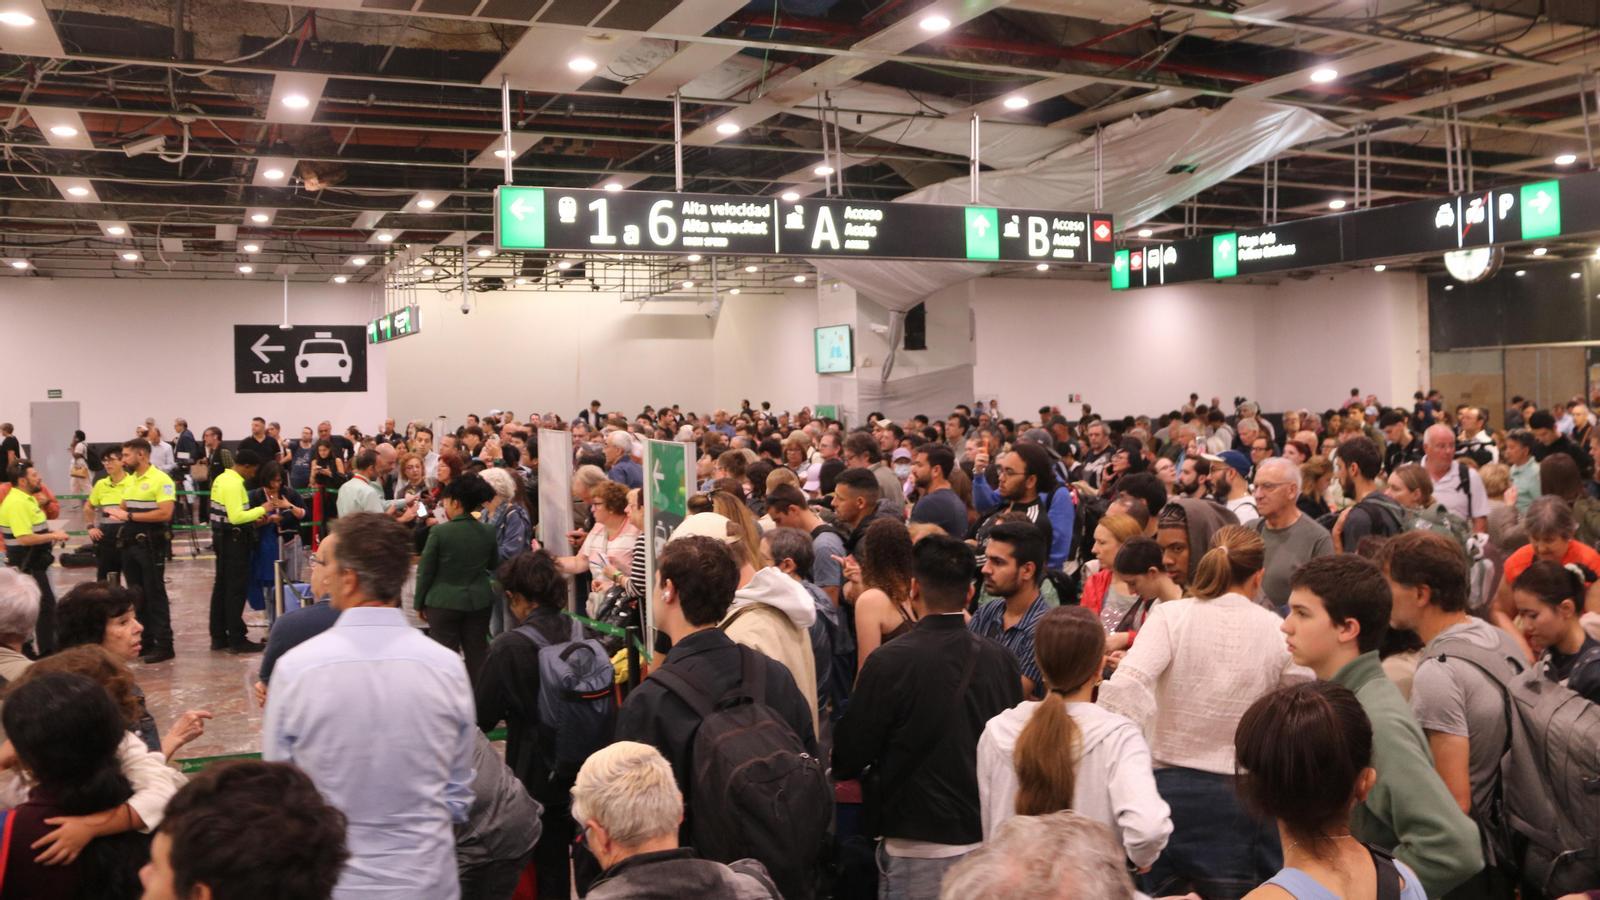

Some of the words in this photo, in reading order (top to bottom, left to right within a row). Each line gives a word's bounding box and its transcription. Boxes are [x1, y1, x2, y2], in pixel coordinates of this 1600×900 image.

[682, 201, 707, 215] Alta
[710, 202, 770, 217] velocidad
[844, 206, 882, 221] Acceso
[1499, 193, 1514, 219] P
[589, 198, 617, 244] 1
[623, 224, 640, 245] a
[648, 200, 677, 246] 6
[682, 219, 709, 233] Alta
[811, 206, 840, 249] A
[1053, 218, 1084, 231] Acceso
[1028, 216, 1050, 256] B
[253, 370, 285, 384] Taxi
